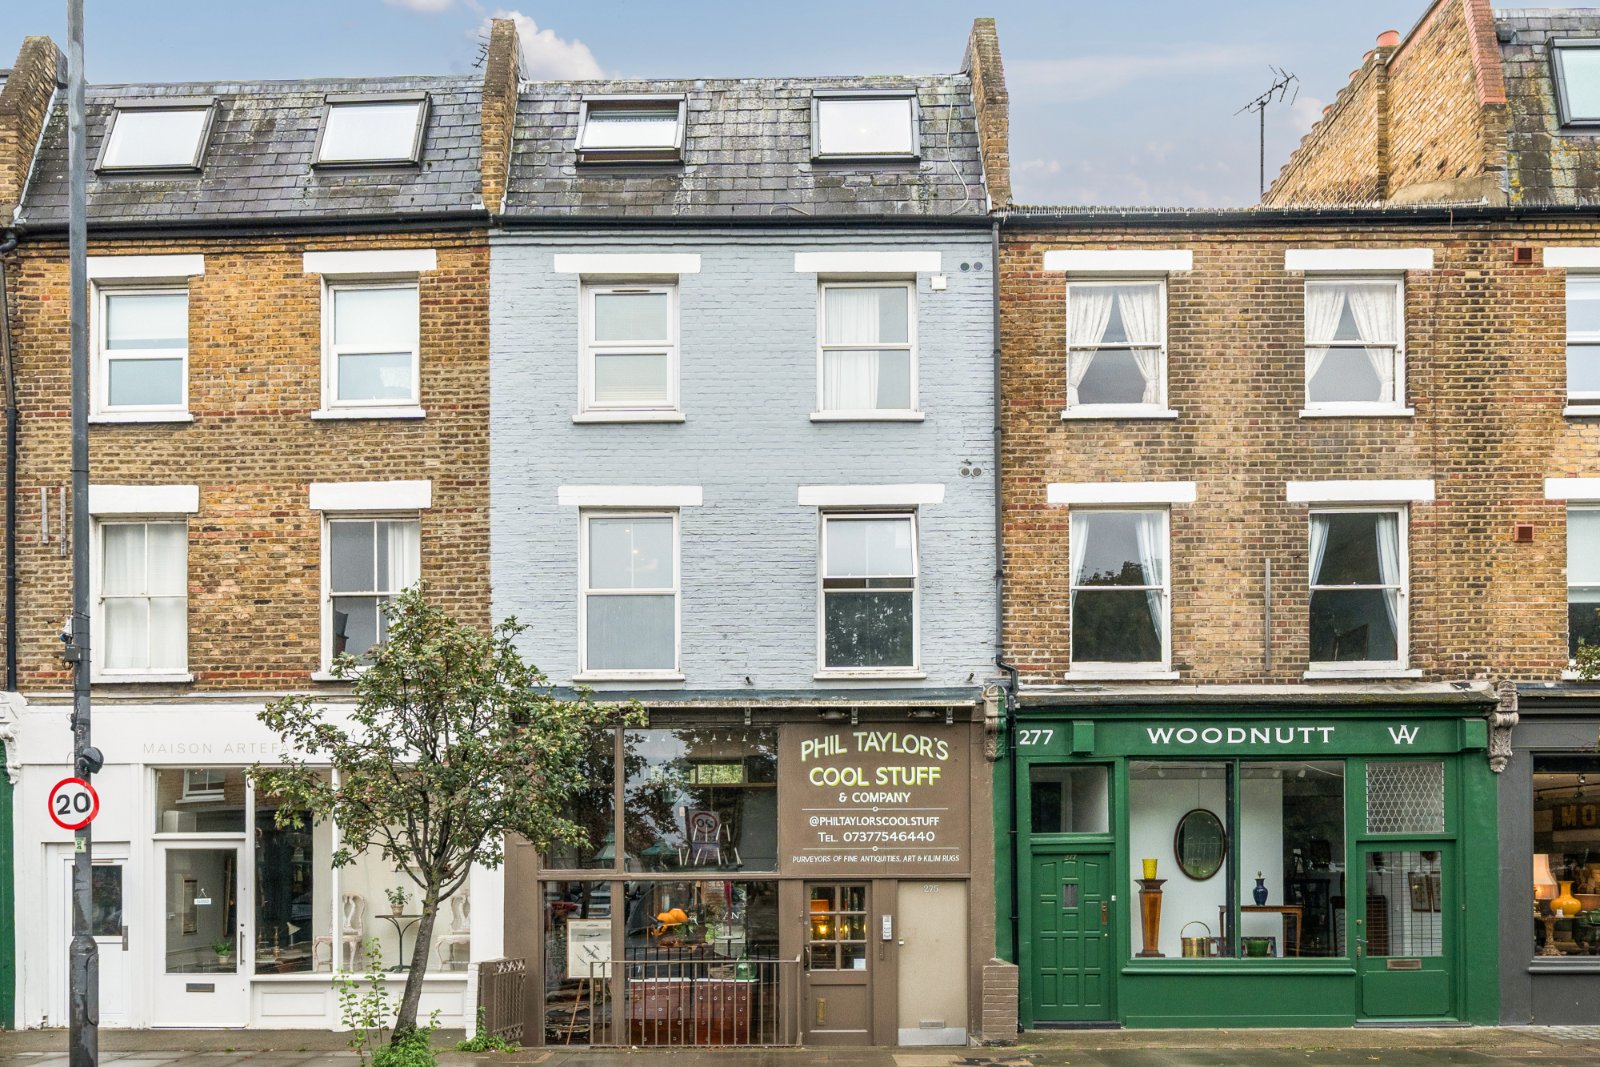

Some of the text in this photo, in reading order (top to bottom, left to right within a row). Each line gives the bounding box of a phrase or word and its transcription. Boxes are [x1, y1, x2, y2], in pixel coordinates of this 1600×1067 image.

[1019, 730, 1053, 745] 277
[1146, 727, 1335, 744] WOODNUTT
[143, 743, 307, 754] MAISON ARTEFAC
[801, 731, 949, 762] PHIL TAYLOR'S
[809, 766, 941, 786] COOL STUFF
[56, 792, 91, 816] 20
[838, 792, 911, 803] & COMPANY
[809, 816, 940, 827] @PHILTAYLORSCOOLSTUFF
[843, 831, 936, 843] 07377546440
